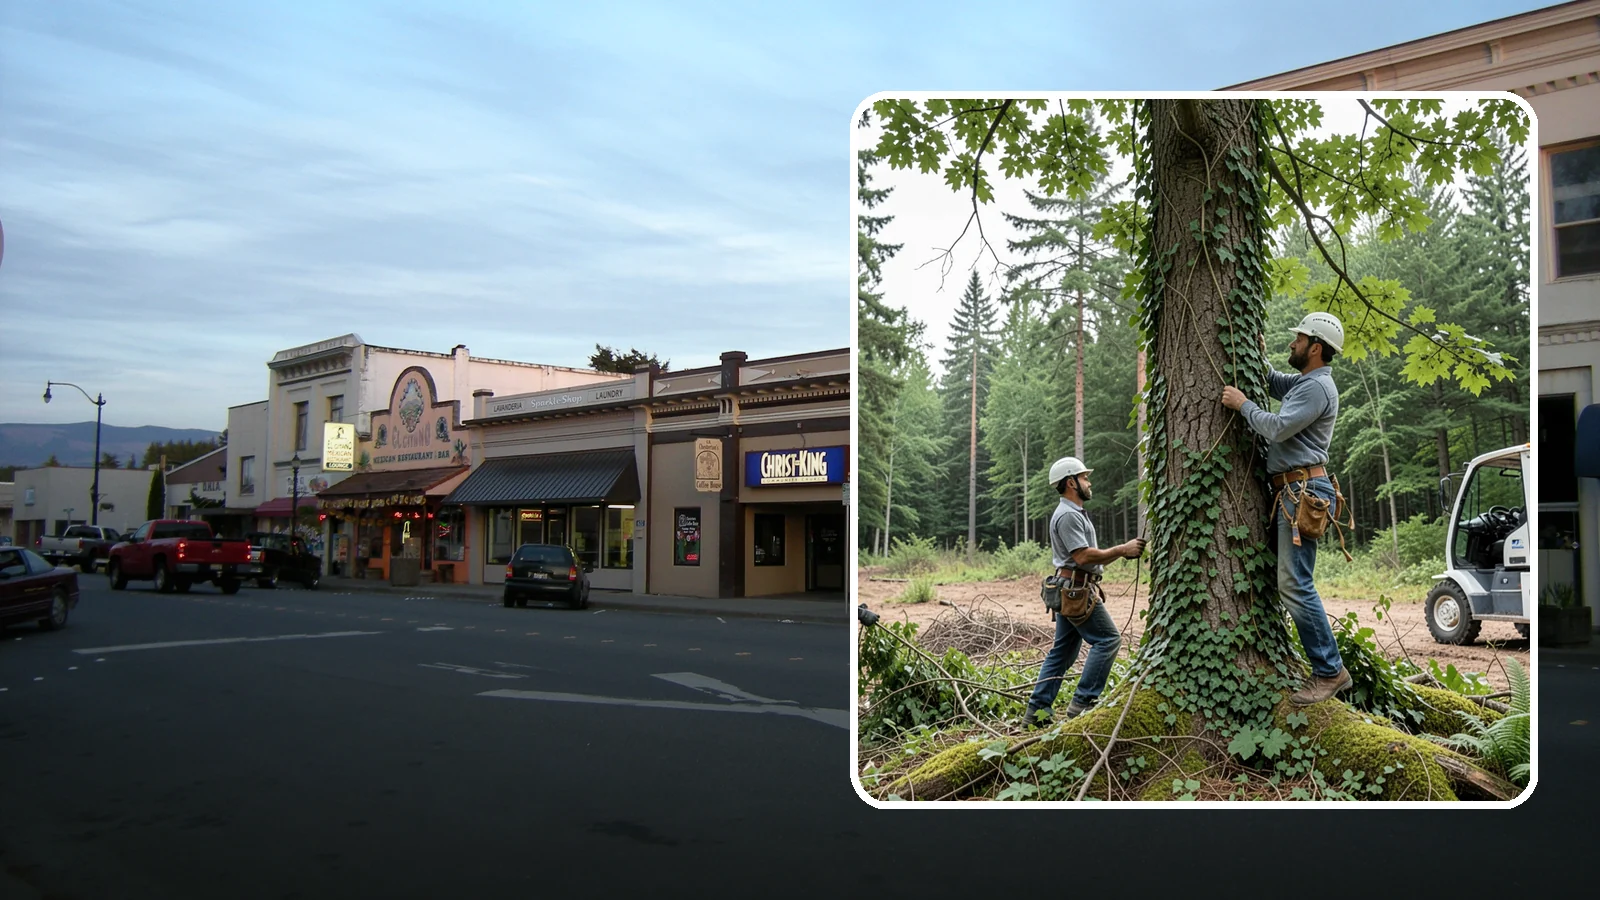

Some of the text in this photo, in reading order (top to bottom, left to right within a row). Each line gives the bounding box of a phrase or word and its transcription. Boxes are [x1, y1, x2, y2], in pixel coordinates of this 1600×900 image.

[595, 388, 623, 399] LAUNDRY
[561, 394, 582, 405] Shop
[493, 402, 522, 412] LAVANDERIA
[373, 454, 396, 464] MEXICAN
[397, 451, 433, 462] RESTAURANT
[438, 450, 450, 459] BAR
[761, 450, 827, 478] CHRIST KING
